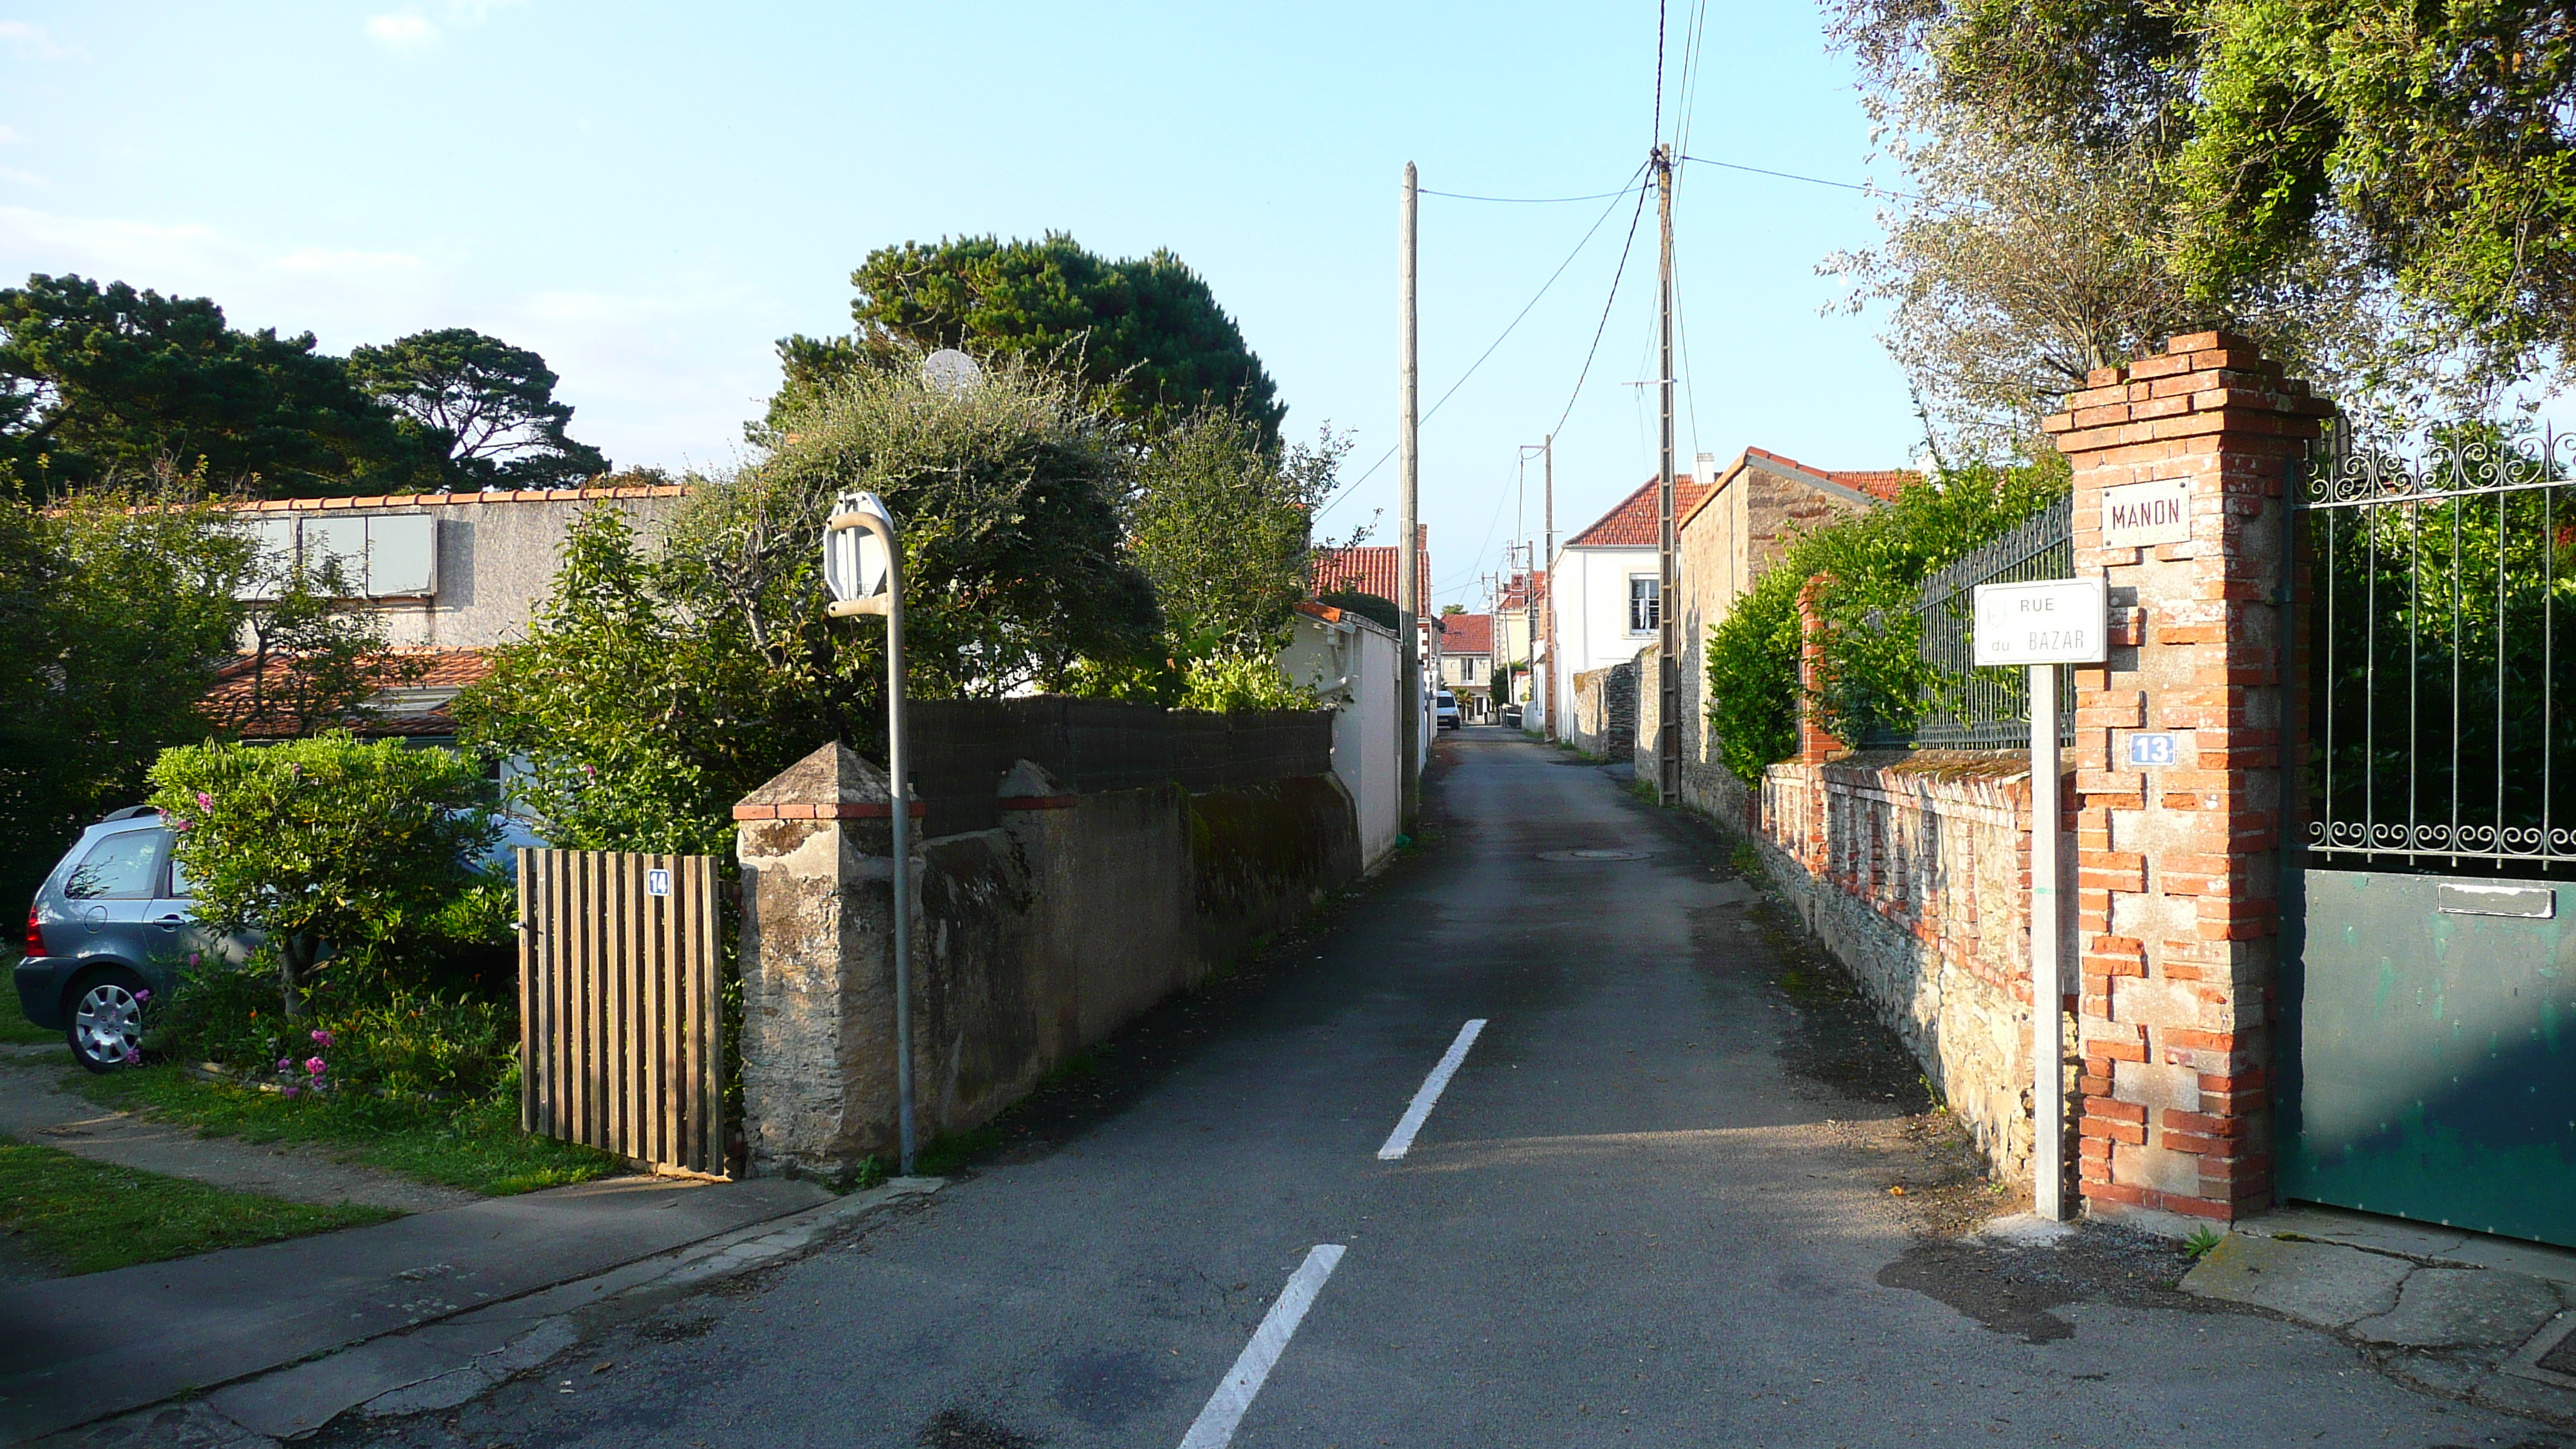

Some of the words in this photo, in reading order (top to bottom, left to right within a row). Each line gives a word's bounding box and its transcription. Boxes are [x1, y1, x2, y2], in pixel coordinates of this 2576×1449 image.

[2112, 498, 2179, 530] MANON
[2020, 598, 2054, 612] RUE
[1992, 639, 2010, 652] du
[2029, 630, 2084, 651] BAZAR
[2136, 736, 2168, 762] 13
[650, 872, 667, 893] 14
